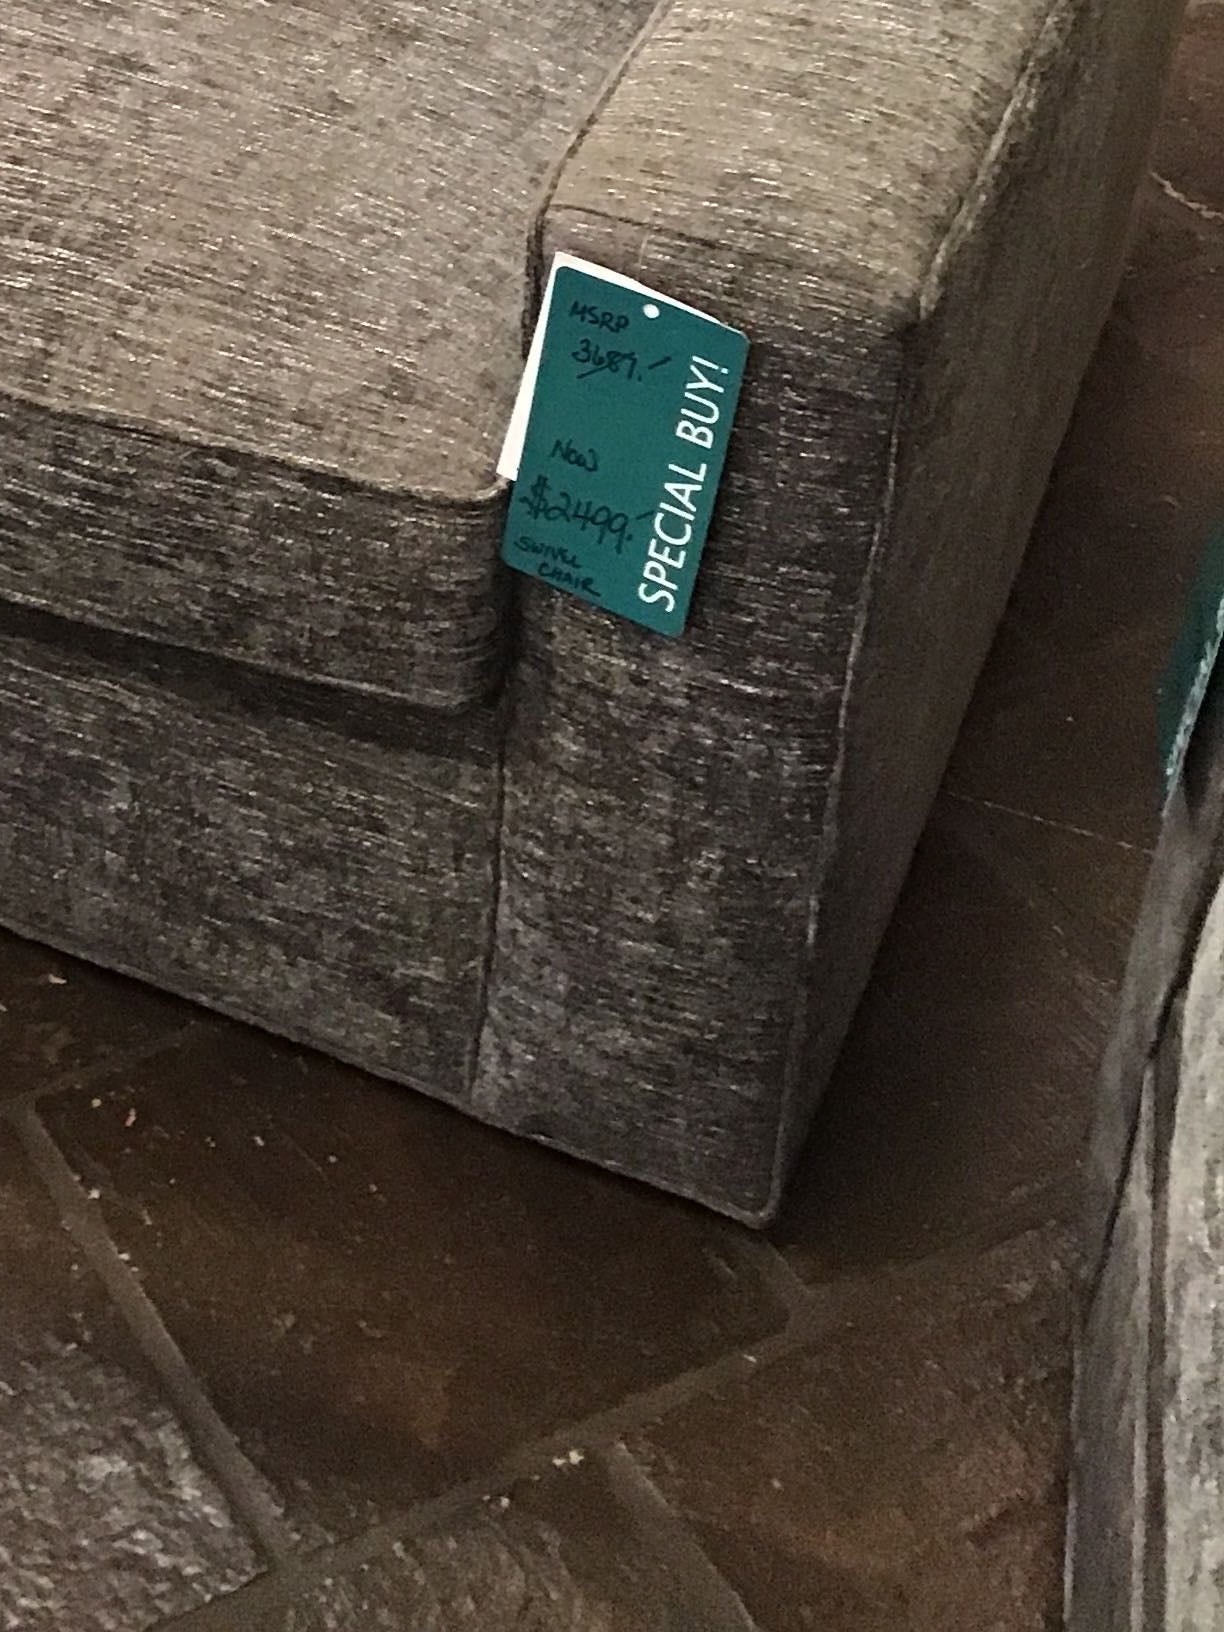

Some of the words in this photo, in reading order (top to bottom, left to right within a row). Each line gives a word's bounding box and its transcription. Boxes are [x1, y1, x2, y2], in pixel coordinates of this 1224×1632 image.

[569, 300, 629, 333] MSRP
[638, 463, 707, 612] SPECIAL
[675, 355, 729, 449] BUY!
[537, 562, 601, 597] CHAIR
